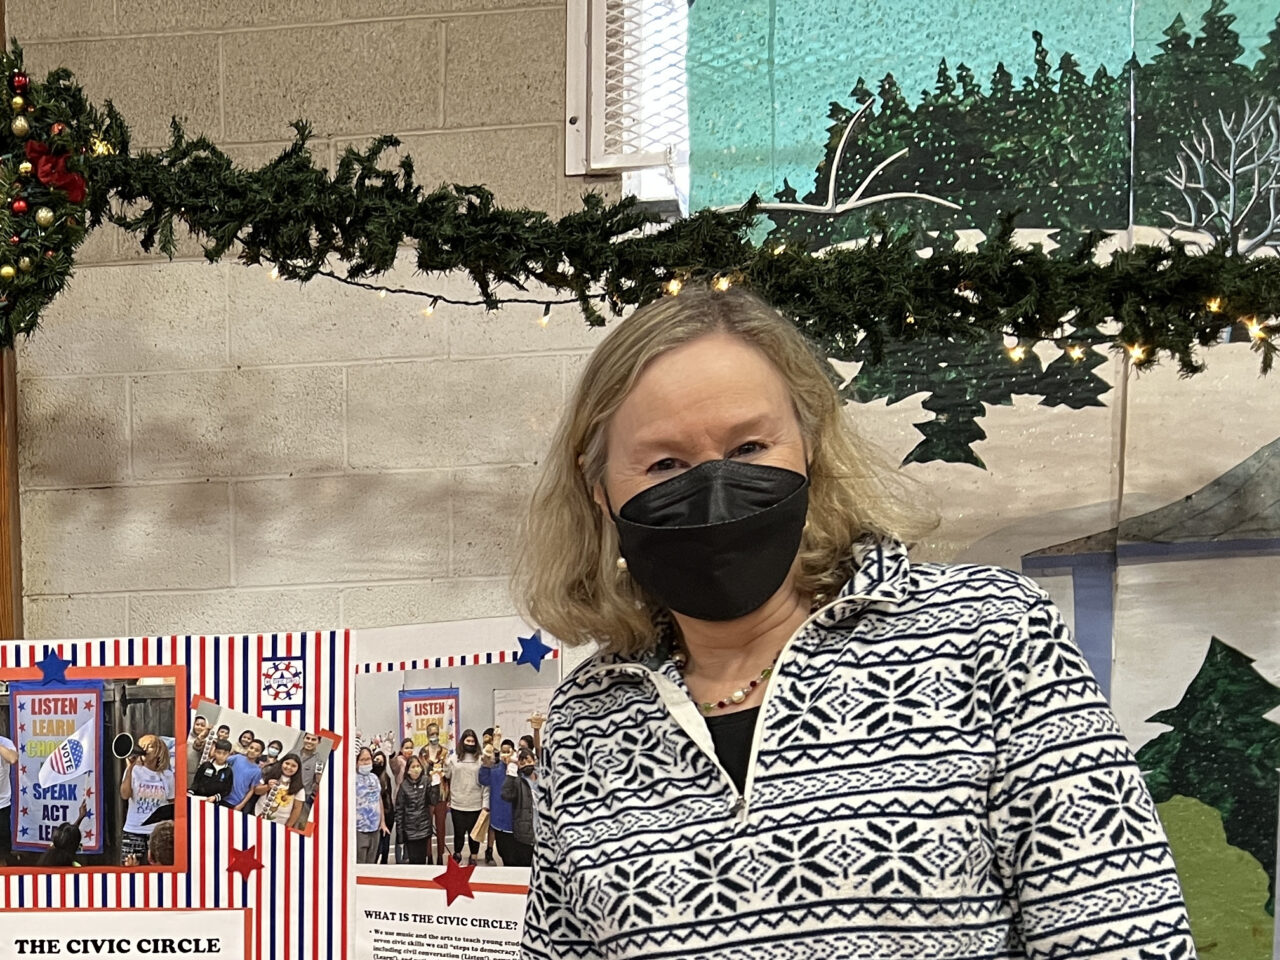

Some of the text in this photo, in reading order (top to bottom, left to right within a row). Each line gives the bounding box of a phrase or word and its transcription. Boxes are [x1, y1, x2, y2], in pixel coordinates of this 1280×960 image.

[30, 698, 78, 715] LISTEN
[414, 702, 444, 716] LISTEN
[32, 719, 76, 736] LEARN
[61, 744, 74, 772] VOTE
[32, 783, 77, 800] SPEAK
[42, 804, 69, 821] ACT
[38, 824, 58, 840] LE
[363, 909, 518, 930] WHAT IS THE CIVIC CIRCLE?
[14, 937, 221, 954] THE CIVIC CIRCLE
